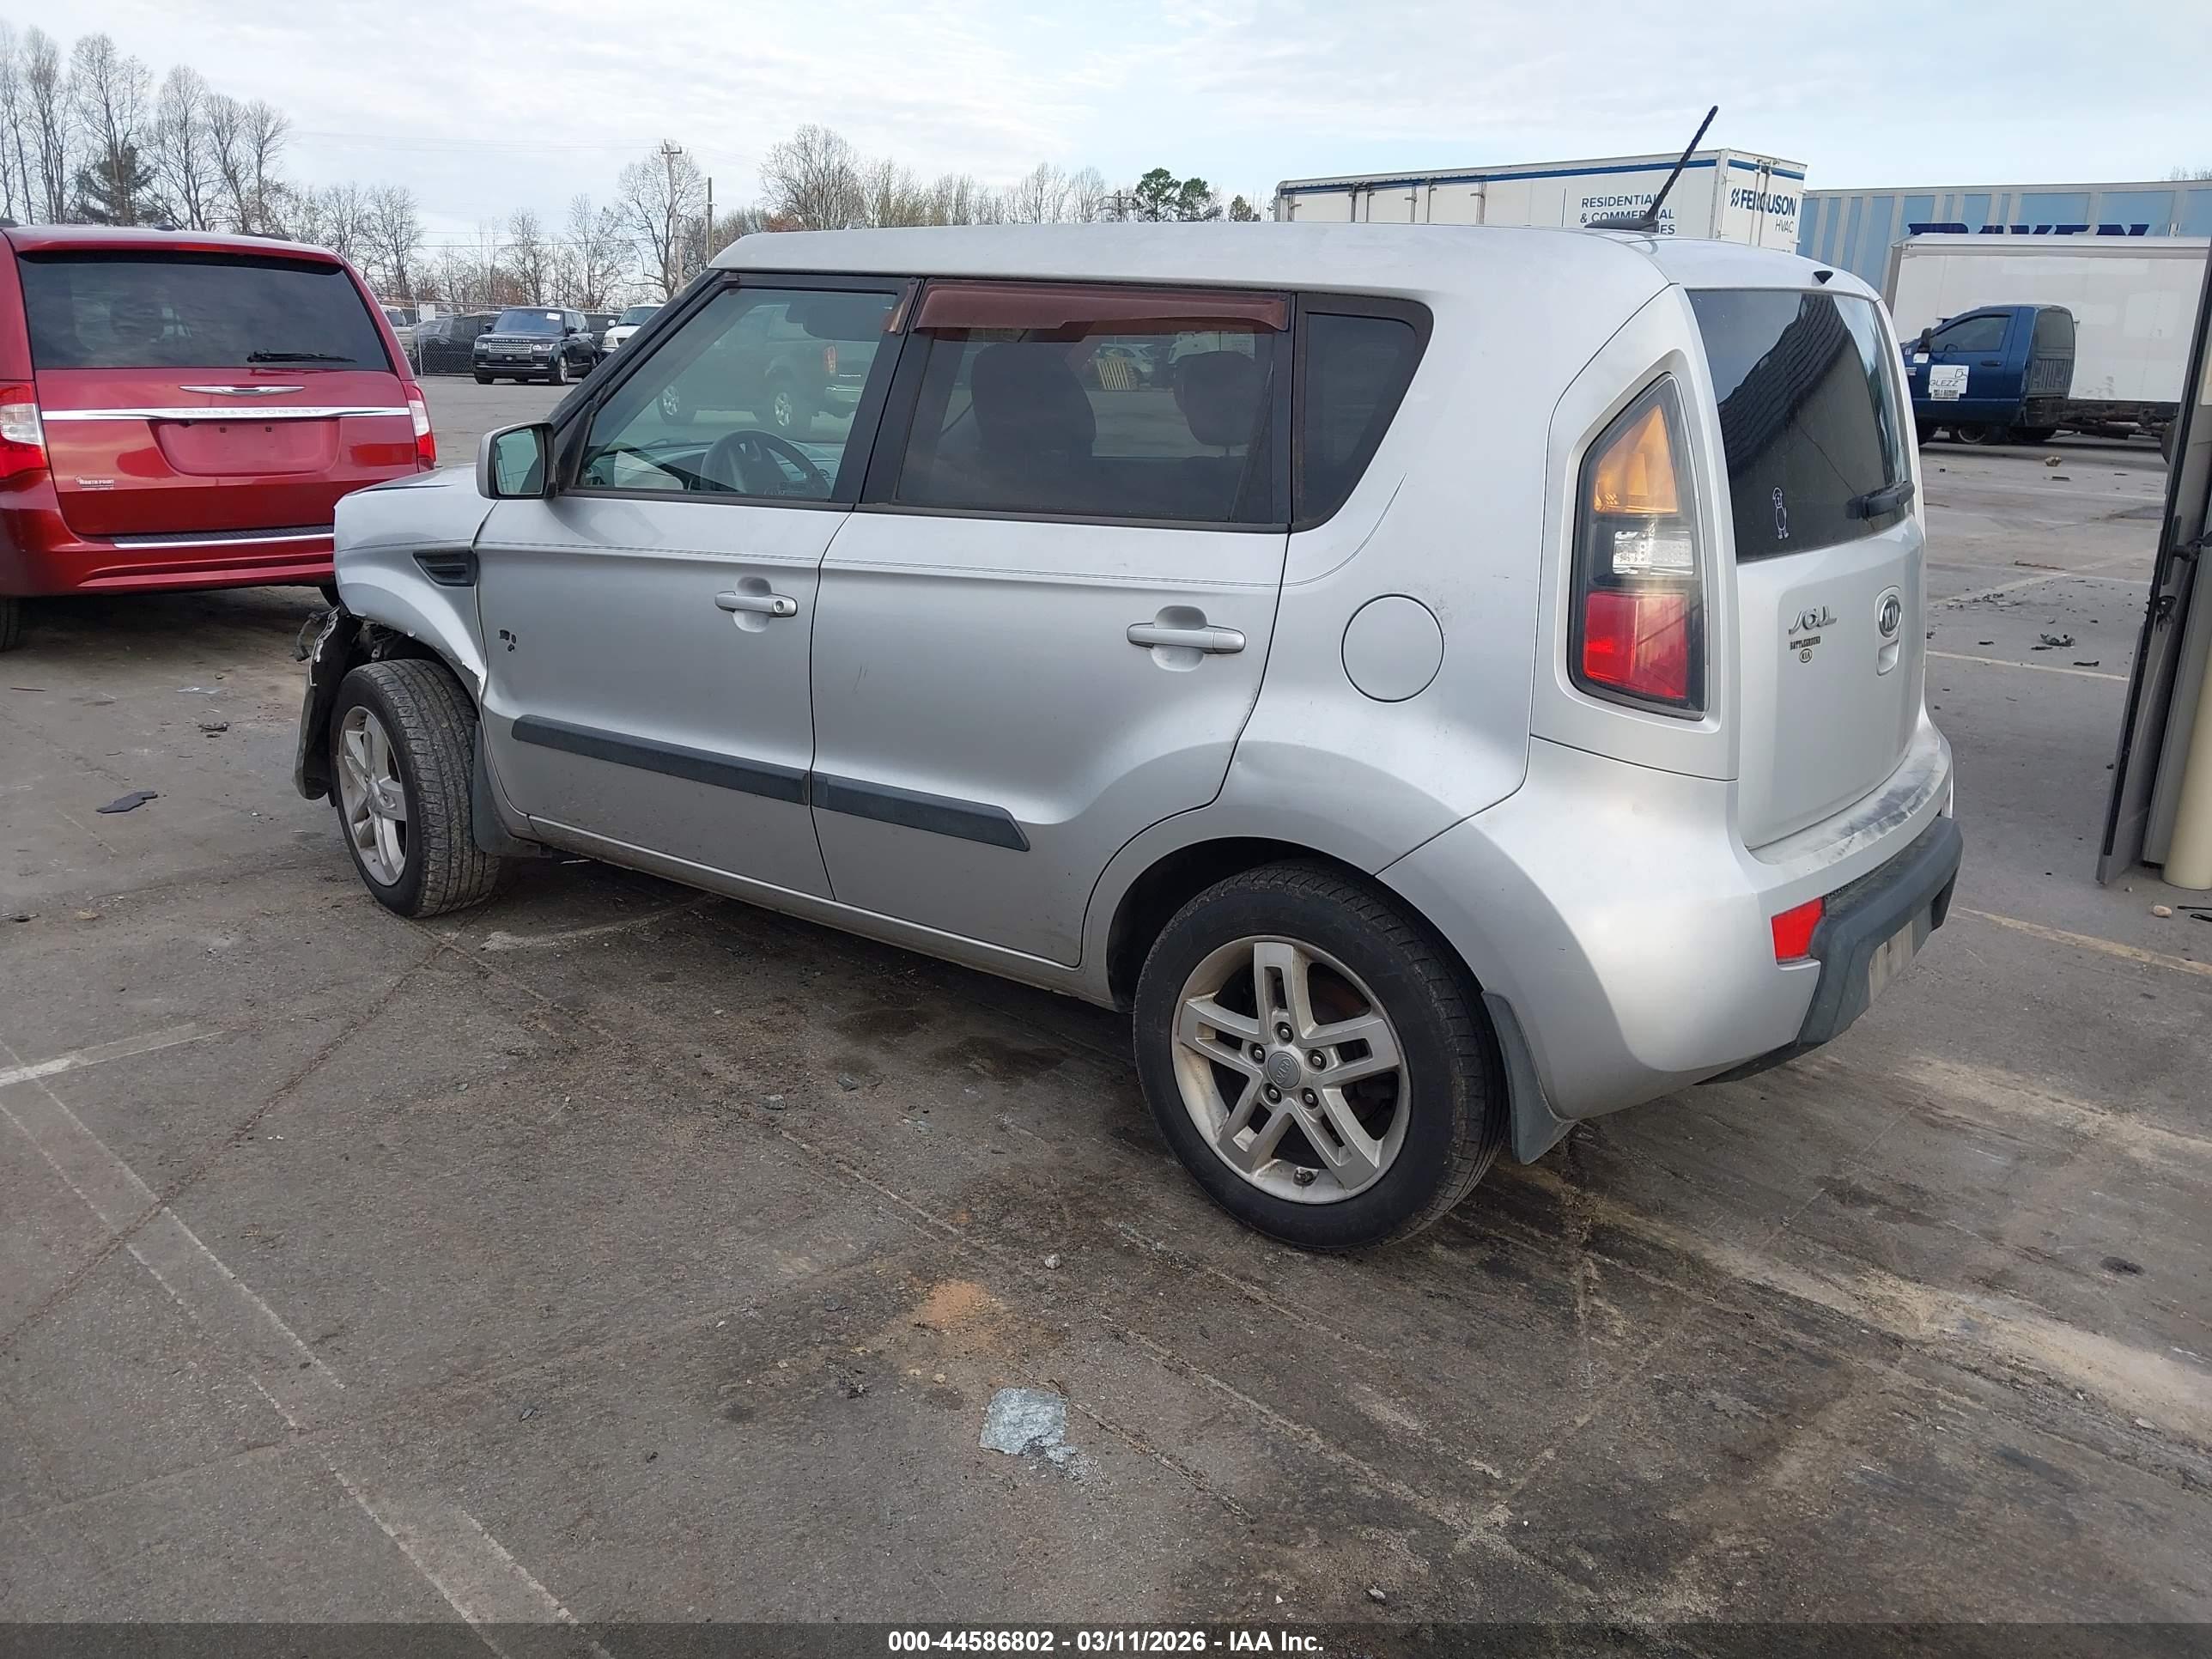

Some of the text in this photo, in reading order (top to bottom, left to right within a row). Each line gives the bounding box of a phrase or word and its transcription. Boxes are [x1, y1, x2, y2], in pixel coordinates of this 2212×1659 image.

[1740, 189, 1797, 217] FERGUSON
[1580, 209, 1674, 223] & COMMERIAL
[1775, 218, 1795, 234] HVAC
[1801, 651, 1812, 660] KIA
